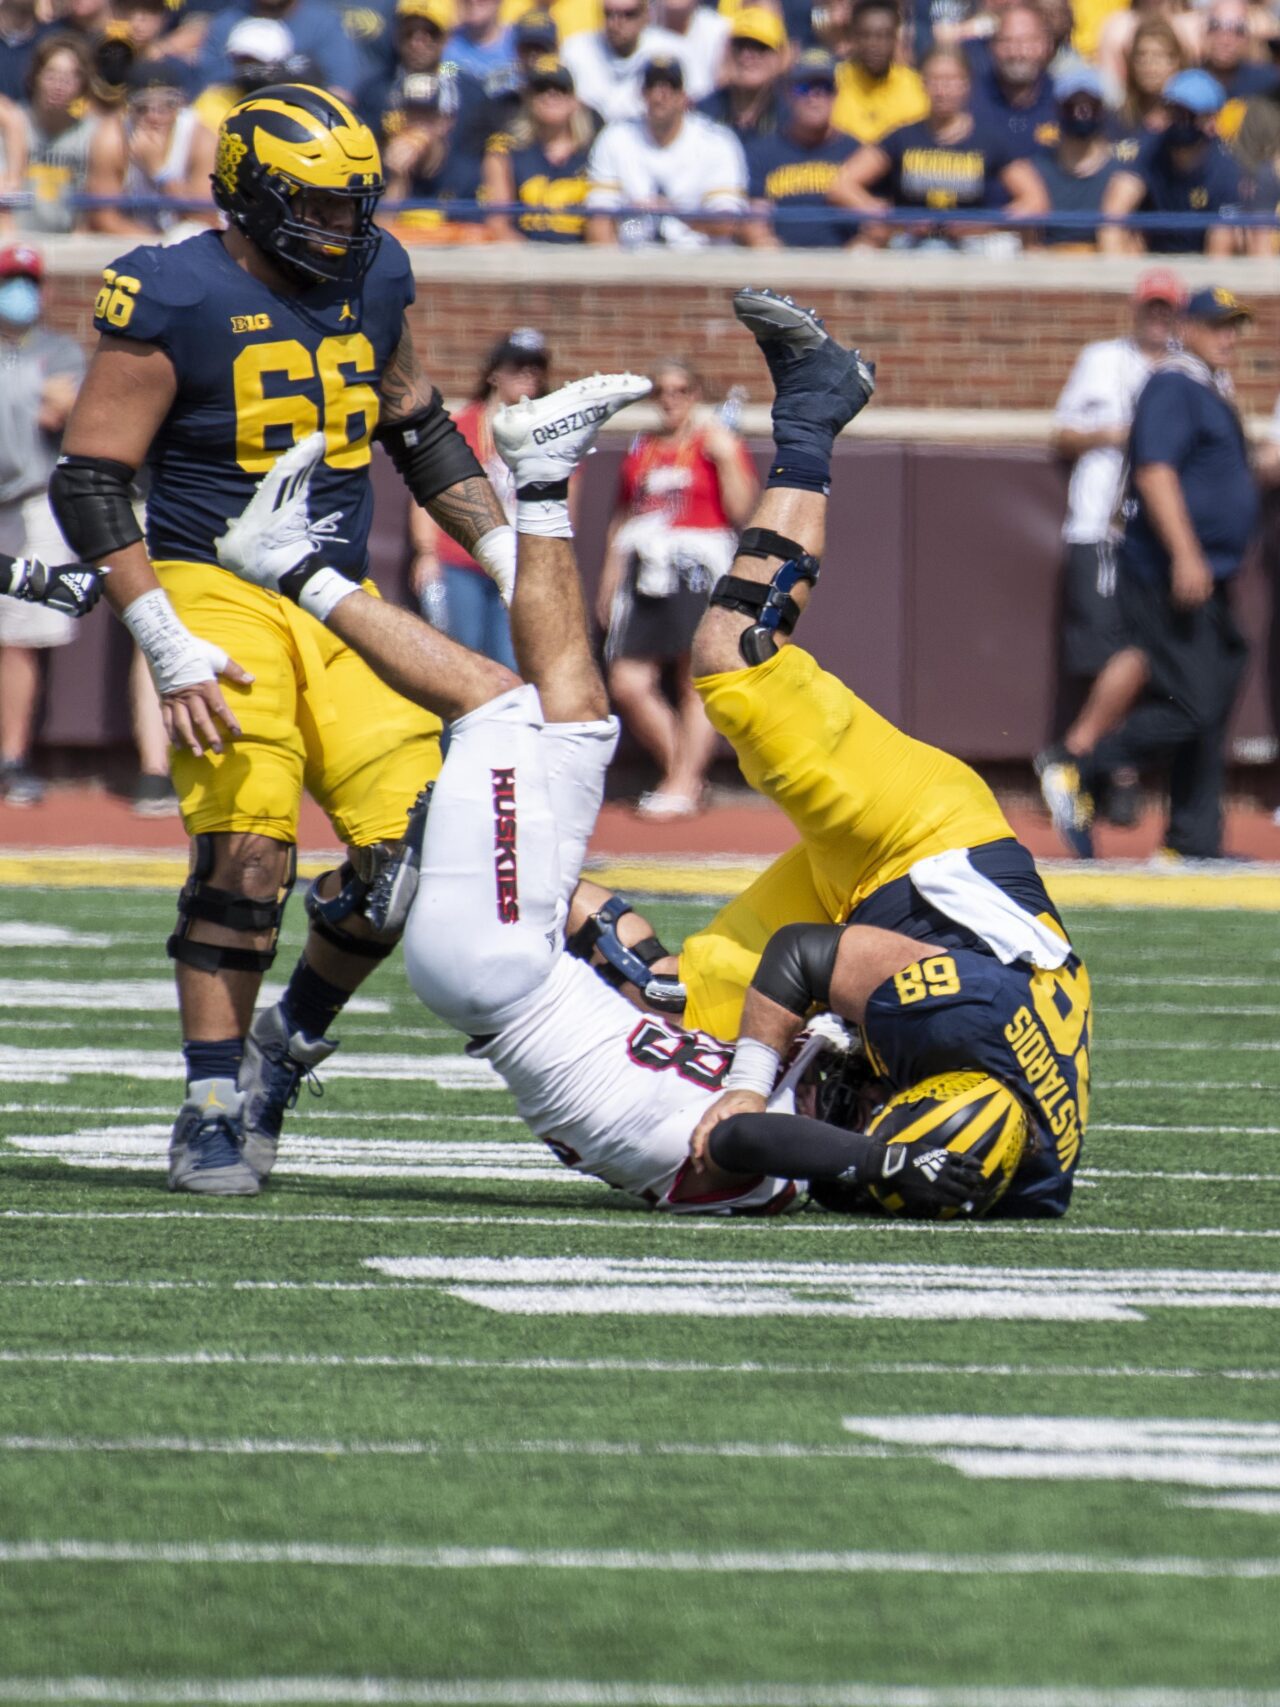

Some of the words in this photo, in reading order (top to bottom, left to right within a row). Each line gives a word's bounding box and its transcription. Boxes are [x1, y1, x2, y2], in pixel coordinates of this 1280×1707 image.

[95, 269, 141, 328] 66
[233, 332, 380, 473] 66
[531, 401, 610, 446] ADIZERO
[490, 767, 520, 925] HUSKIES
[893, 953, 961, 1006] 68
[1003, 1005, 1081, 1174] VASTARDIS
